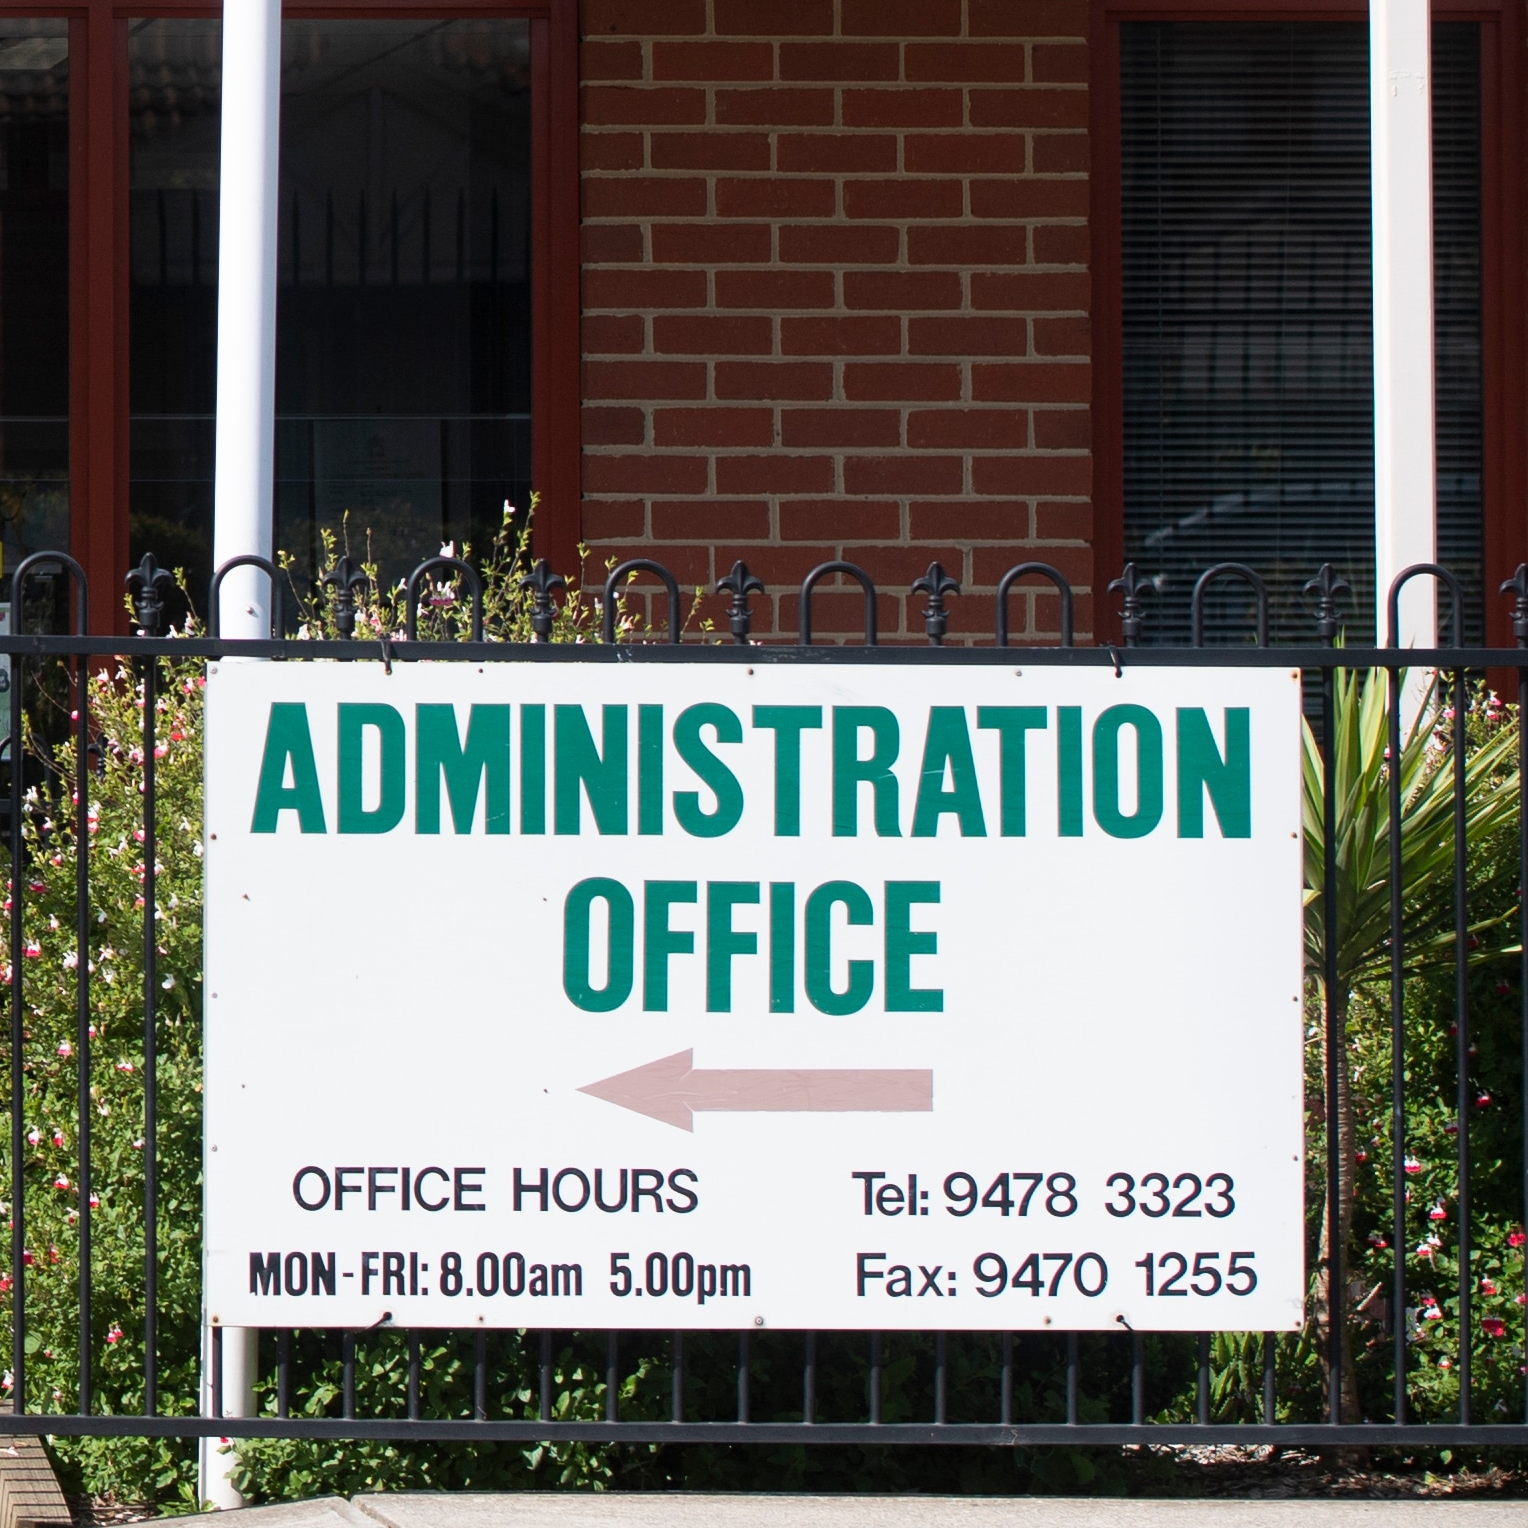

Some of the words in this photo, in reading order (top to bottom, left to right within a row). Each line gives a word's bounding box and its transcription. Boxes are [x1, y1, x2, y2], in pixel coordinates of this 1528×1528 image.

[249, 701, 1253, 840] ADMINISTRATION
[563, 876, 944, 1017] OFFICE
[292, 1165, 487, 1213] OFFICE
[512, 1166, 699, 1215] HOURS
[852, 1171, 929, 1217] Tel:
[943, 1171, 1079, 1219] 9478
[1104, 1171, 1236, 1219] 3323
[439, 1250, 583, 1298] 8.00am
[609, 1251, 752, 1306] 5.00pm
[856, 1251, 957, 1299] Fax:
[973, 1251, 1109, 1299] 9470
[1135, 1250, 1259, 1298] 1255
